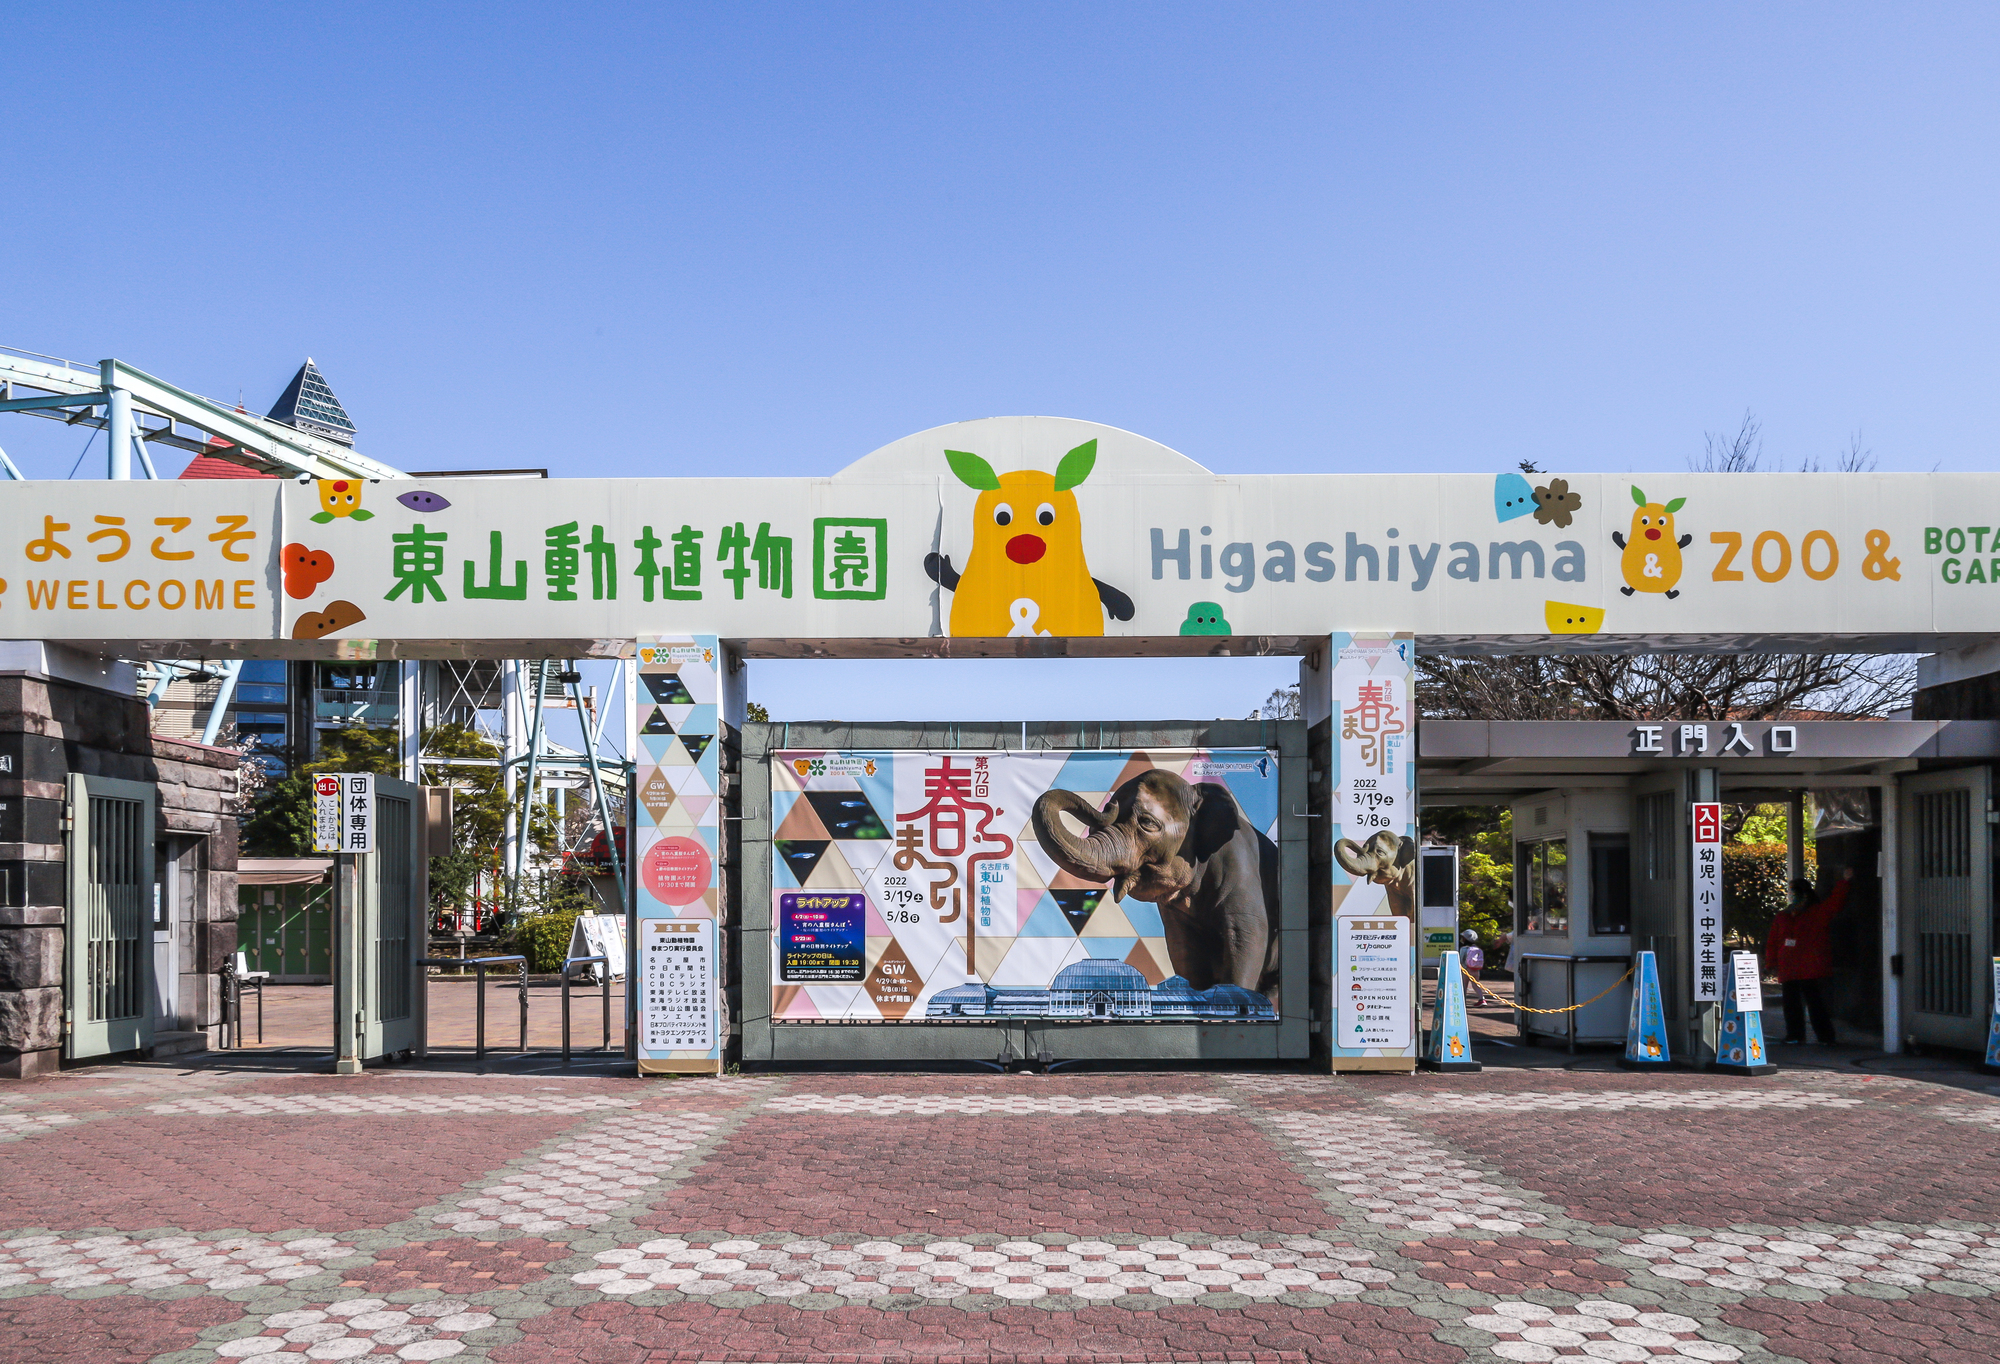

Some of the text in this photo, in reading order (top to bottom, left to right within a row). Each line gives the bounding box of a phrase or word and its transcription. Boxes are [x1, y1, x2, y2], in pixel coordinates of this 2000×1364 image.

[25, 514, 257, 562] ようこそ
[1710, 529, 1901, 583] ZOO &
[384, 517, 887, 603] 東山動植物園
[1150, 525, 1586, 594] Higashiyama
[26, 579, 256, 610] WELCOME
[1636, 722, 1796, 752] 正門入口
[318, 782, 337, 792] 出口
[974, 756, 989, 797] 第72回
[1353, 779, 1377, 788] 2022
[318, 800, 326, 840] 入れません
[328, 800, 336, 840] ここからは
[350, 778, 367, 849] 団体専用
[1698, 808, 1716, 840] 入口
[884, 877, 906, 886] 2022
[980, 872, 1003, 883] 東山
[796, 897, 850, 908] ライトアップ
[980, 885, 990, 926] 動植物園
[1699, 848, 1717, 996] 幼児、小・中学生無料
[882, 964, 906, 974] GW
